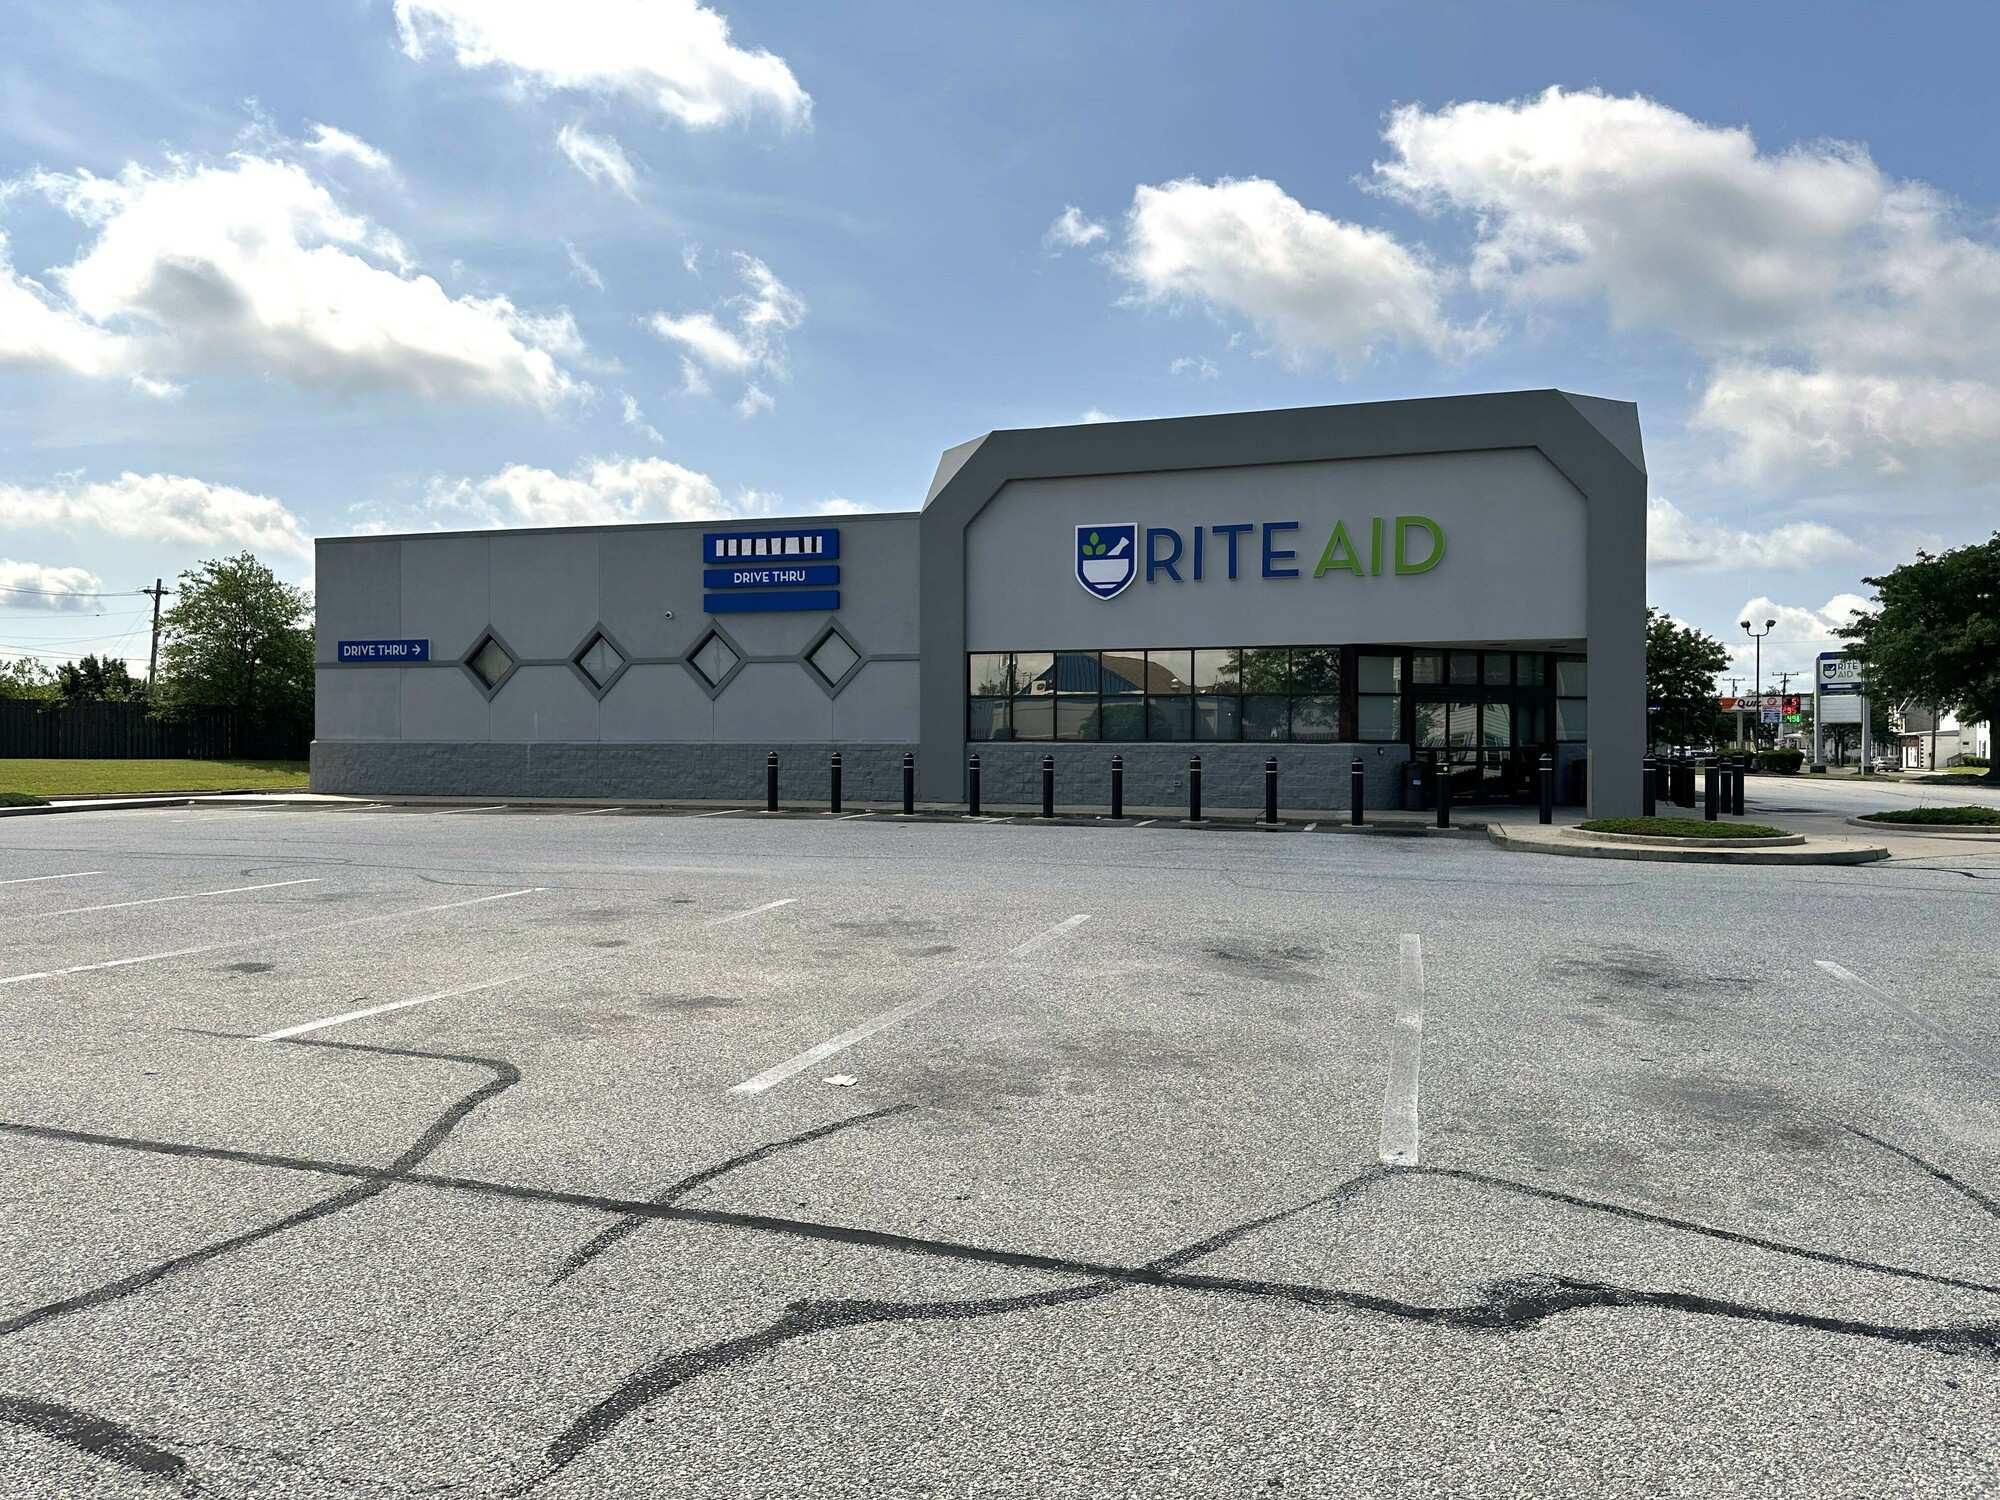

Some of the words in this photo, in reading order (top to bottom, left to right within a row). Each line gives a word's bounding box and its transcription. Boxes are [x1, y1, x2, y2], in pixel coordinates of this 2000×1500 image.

[1146, 521, 1300, 584] RITE
[1312, 515, 1447, 577] AID
[734, 571, 770, 583] DRIVE
[772, 570, 806, 582] THRU
[343, 645, 376, 656] DRIVE
[377, 644, 408, 656] THRU
[1837, 662, 1858, 670] RITE
[1837, 670, 1854, 678] AID
